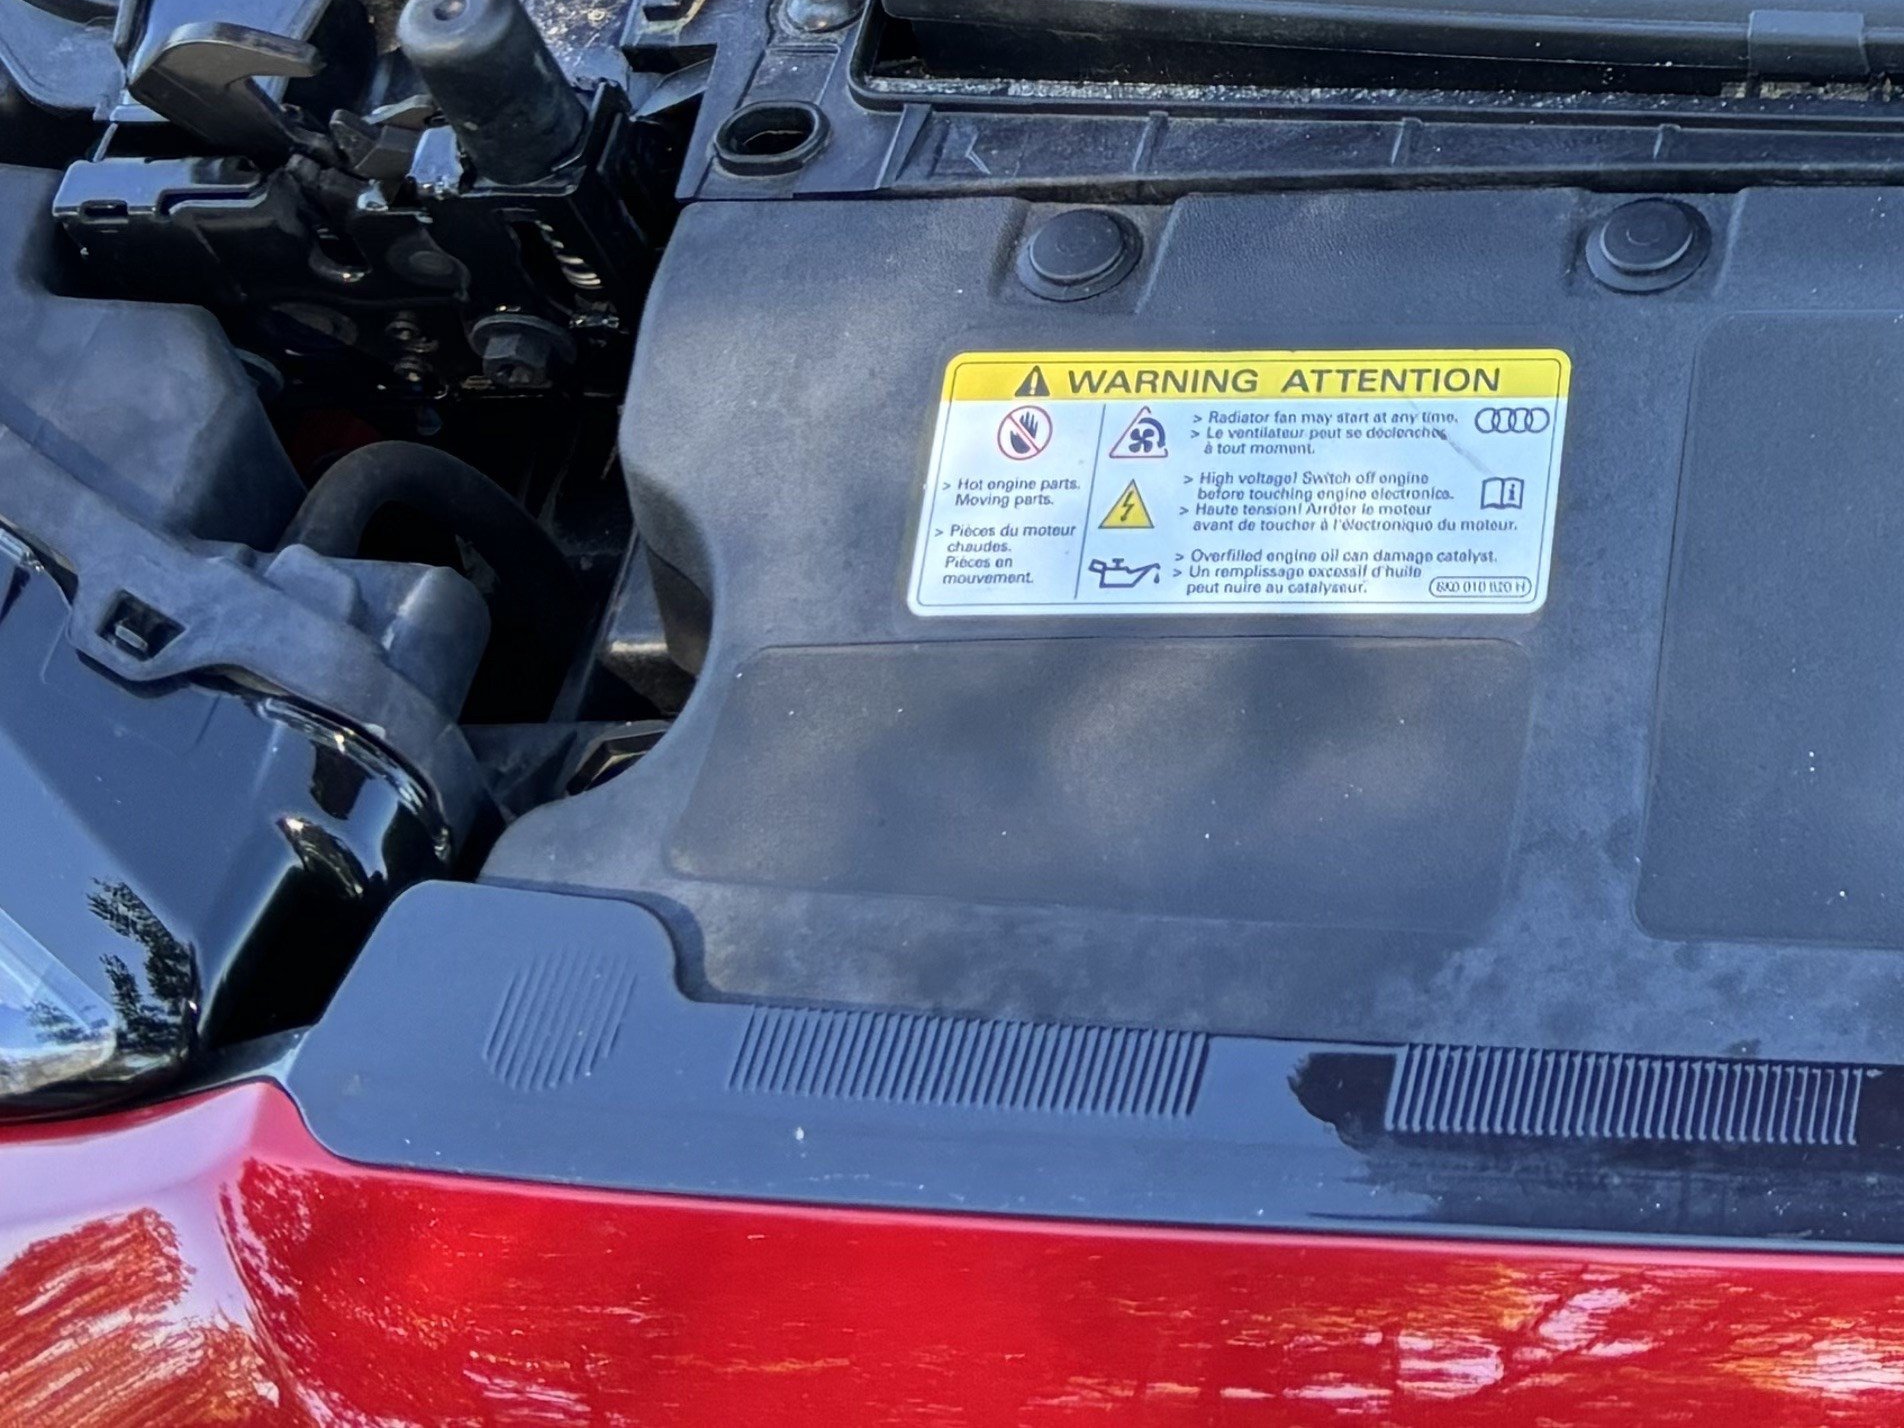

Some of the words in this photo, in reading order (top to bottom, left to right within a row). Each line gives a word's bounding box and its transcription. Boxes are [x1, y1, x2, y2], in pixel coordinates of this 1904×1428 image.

[1068, 370, 1259, 395] WARNING
[1280, 367, 1501, 393] ATTENTION
[1208, 410, 1268, 424] Radiator
[1274, 410, 1297, 424] fan
[1301, 413, 1332, 426] may
[1337, 412, 1369, 424] start
[1373, 412, 1387, 424] at
[1391, 413, 1416, 425] any
[1207, 427, 1223, 439] Le
[1228, 426, 1304, 439] ventilateur
[1309, 427, 1341, 442] peut
[1346, 429, 1362, 439] se
[1204, 442, 1213, 455] à
[1217, 444, 1245, 455] tout
[1250, 444, 1315, 455] moment.
[958, 478, 983, 490] Hot
[987, 477, 1036, 493] engine
[1040, 478, 1080, 492] parts.
[1200, 472, 1234, 489] High
[1302, 472, 1350, 485] Switch
[1355, 472, 1376, 485] off
[1379, 473, 1429, 489] engine
[955, 493, 1010, 508] Moving
[1014, 494, 1054, 509] parts.
[1197, 487, 1244, 500] before
[1249, 487, 1312, 504] touching
[1317, 487, 1367, 504] engine
[1196, 503, 1238, 516] Haute
[1362, 503, 1374, 516] le
[1378, 504, 1432, 516] moteur
[950, 524, 995, 537] Pièces
[1000, 523, 1018, 537] du
[1023, 525, 1076, 536] moteur
[1193, 519, 1233, 531] avant
[1238, 518, 1255, 531] de
[1260, 518, 1316, 531] toucher
[1437, 518, 1456, 531] du
[1460, 519, 1518, 531] moteur.
[947, 541, 1012, 553] chaudes.
[945, 555, 990, 568] Pièces
[995, 557, 1013, 567] en
[1191, 549, 1262, 563] Overfilled
[1266, 549, 1316, 566] engine
[1321, 549, 1338, 563] oil
[1343, 551, 1368, 563] can
[1374, 549, 1432, 566] damage
[1436, 549, 1498, 566] catalyst.
[1189, 565, 1209, 578] Un
[1215, 565, 1304, 582] remplissage
[1308, 565, 1367, 578] excessif
[1186, 582, 1219, 596] peut
[1224, 581, 1261, 594] nuire
[1266, 583, 1284, 594] au
